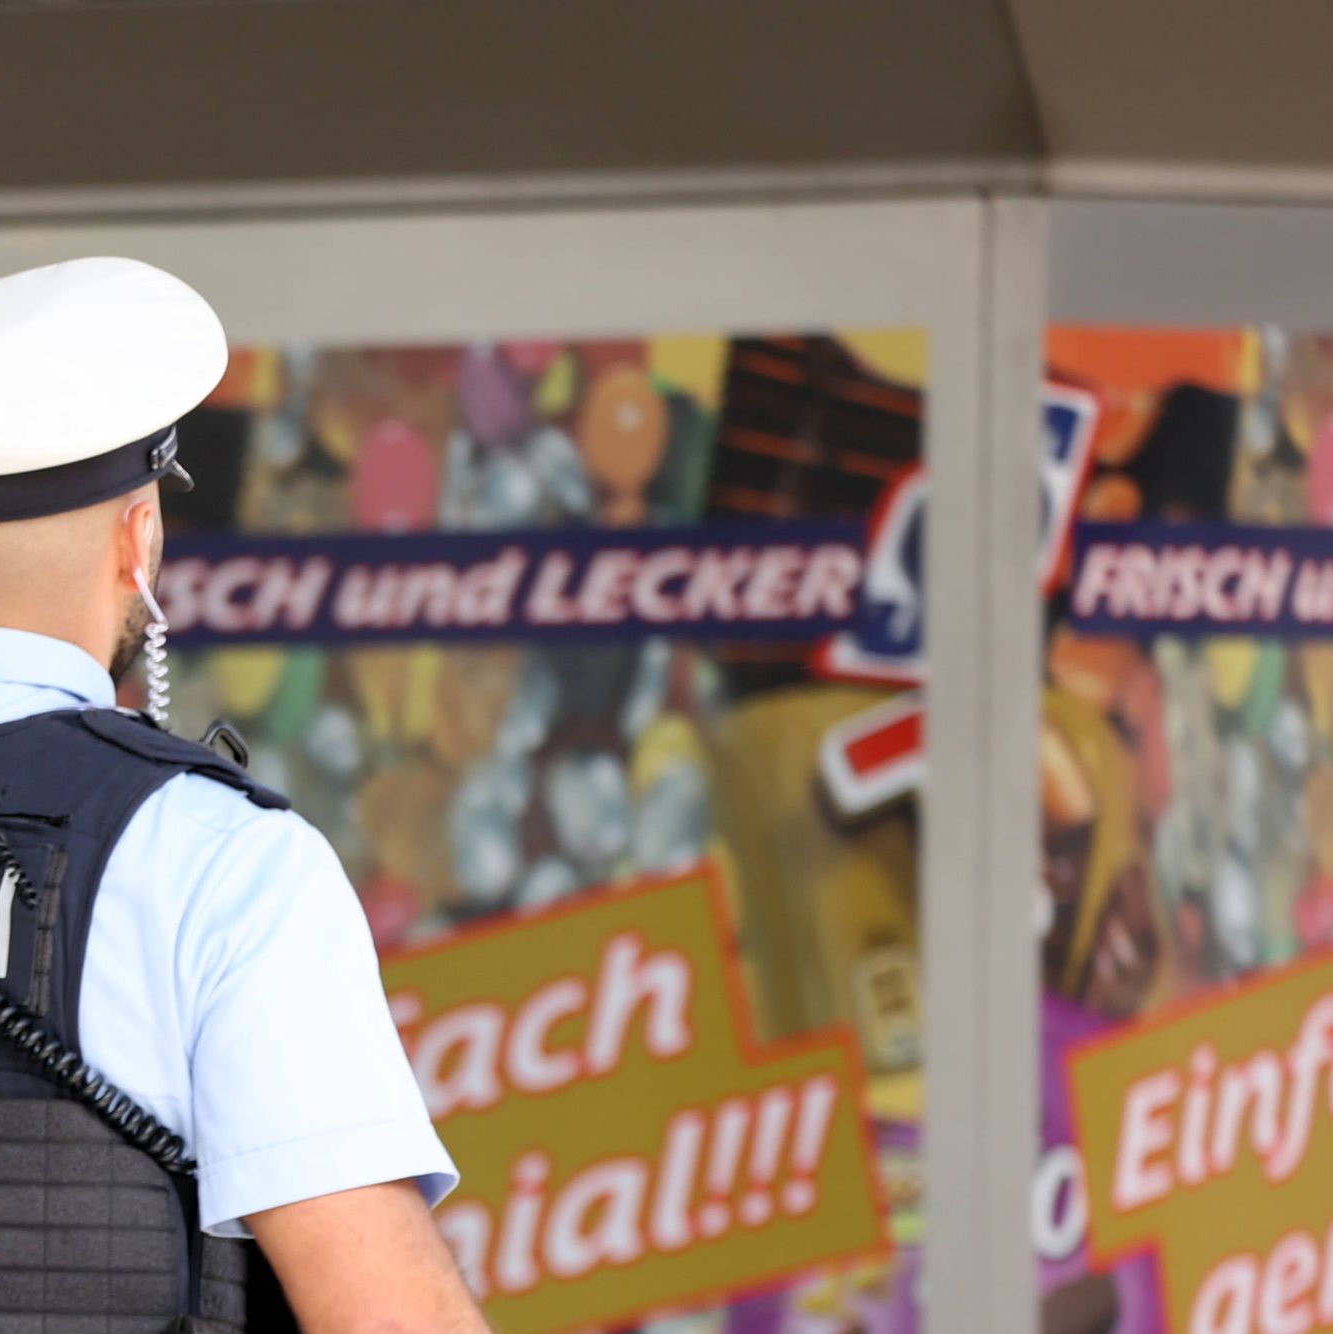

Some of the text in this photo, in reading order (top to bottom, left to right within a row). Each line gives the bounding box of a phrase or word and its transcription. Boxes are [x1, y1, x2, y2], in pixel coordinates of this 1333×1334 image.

[335, 545, 526, 629] und
[527, 541, 864, 626] LECKER
[1072, 541, 1292, 624] FRISCH
[389, 934, 692, 1122] ach
[1111, 996, 1333, 1212] Einf
